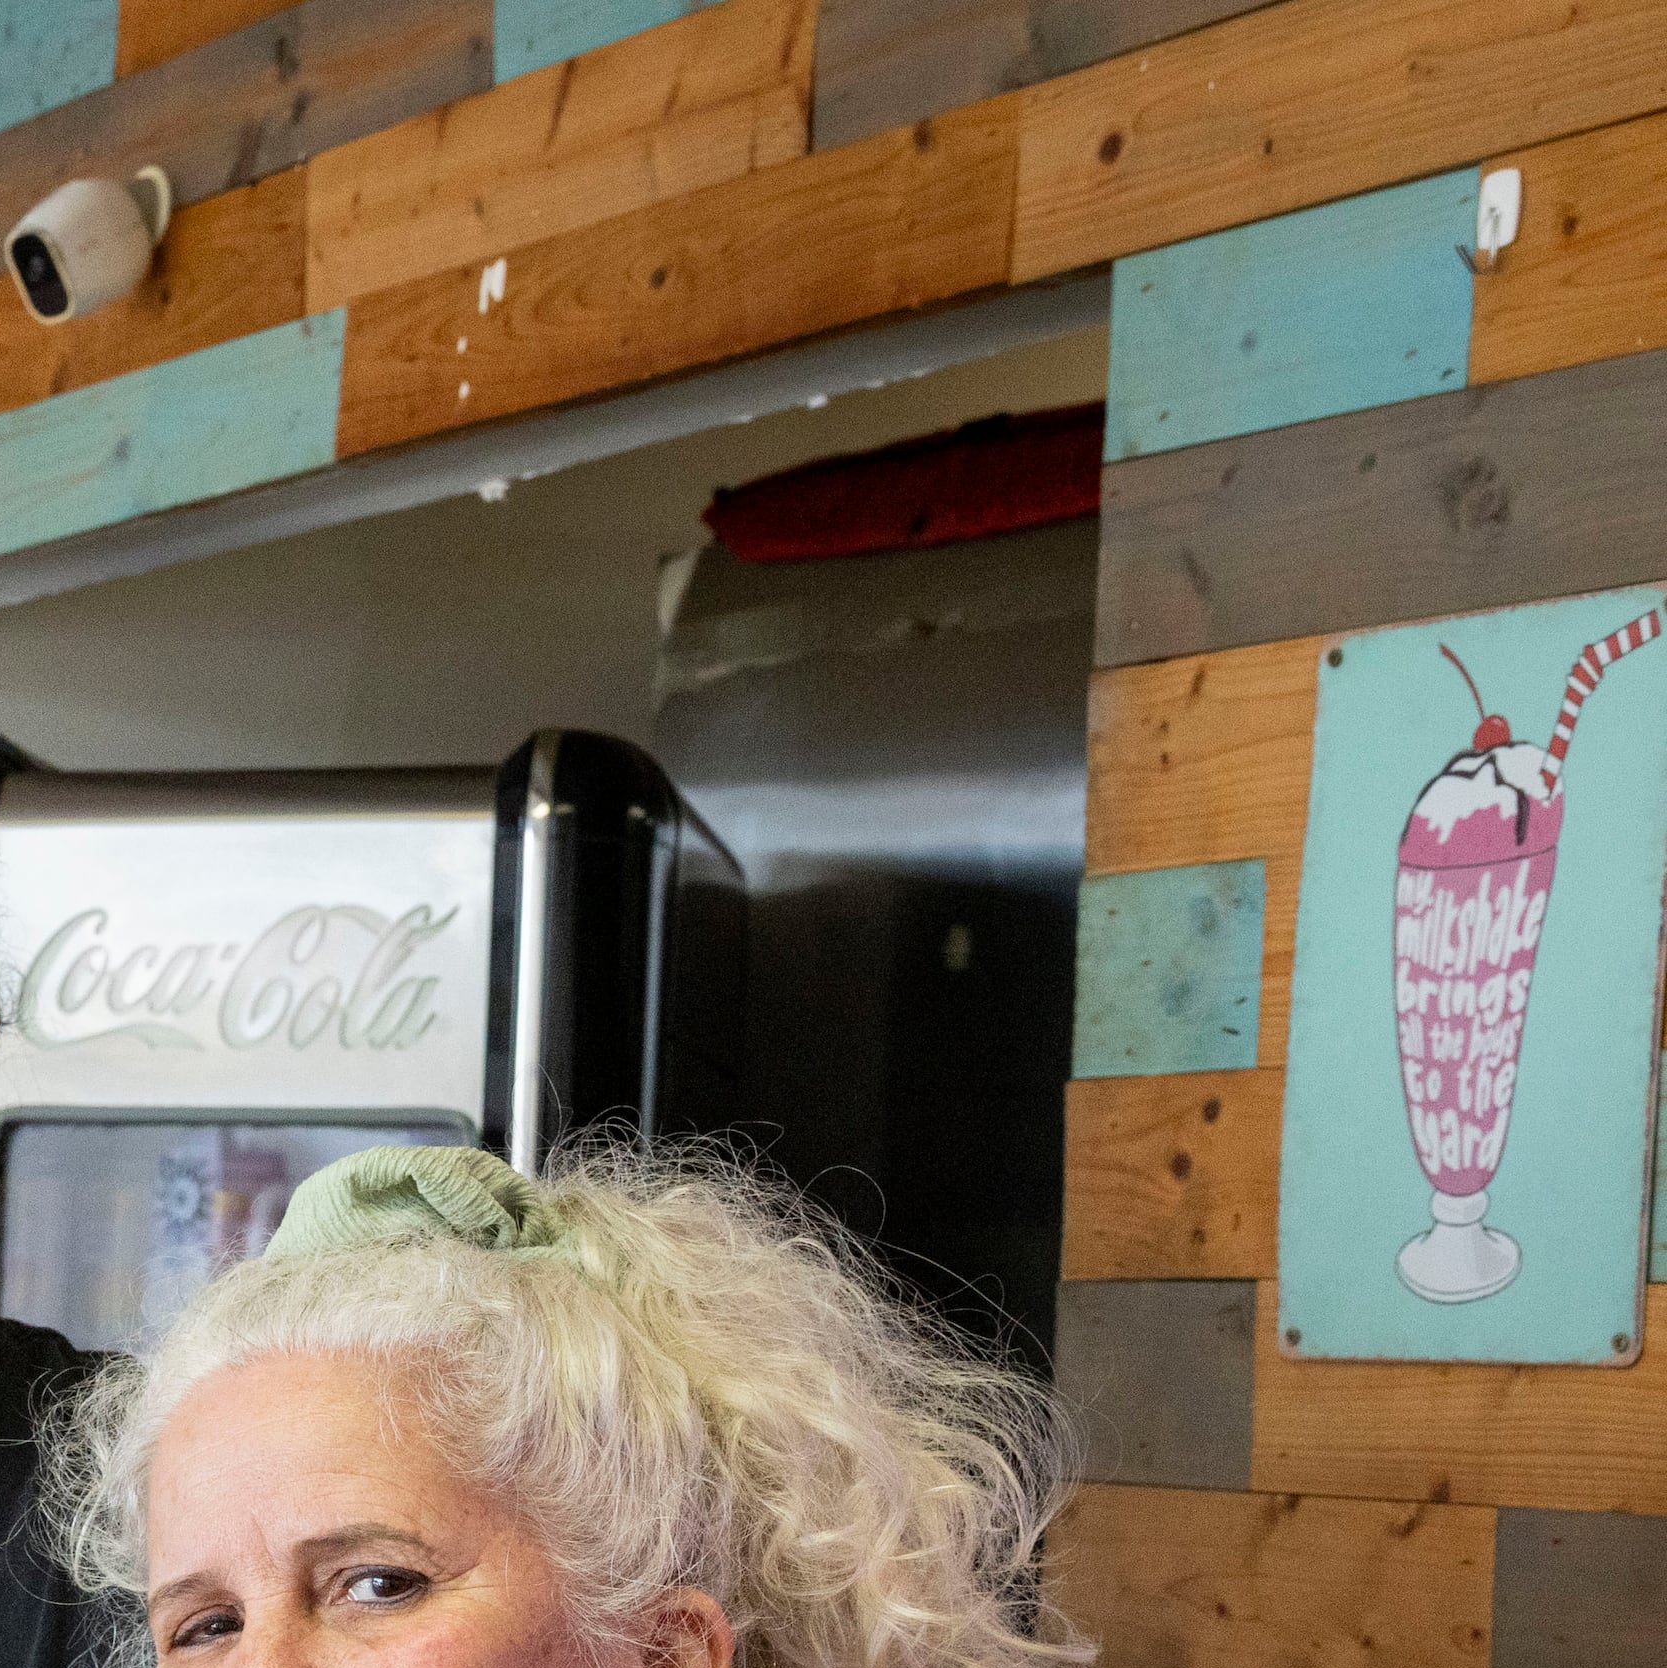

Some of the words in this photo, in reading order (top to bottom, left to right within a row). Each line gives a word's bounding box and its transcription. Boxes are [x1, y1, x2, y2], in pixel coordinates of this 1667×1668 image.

[1398, 871, 1435, 914] my
[1398, 859, 1547, 976] milkshake
[15, 903, 460, 1051] Coca-Cola
[1397, 960, 1531, 1024] brings
[1399, 1014, 1424, 1058] all
[1431, 1022, 1465, 1061] the
[1468, 1013, 1522, 1067] boys
[1404, 1059, 1441, 1102] to
[1458, 1058, 1516, 1118] the
[1411, 1105, 1509, 1175] yard
